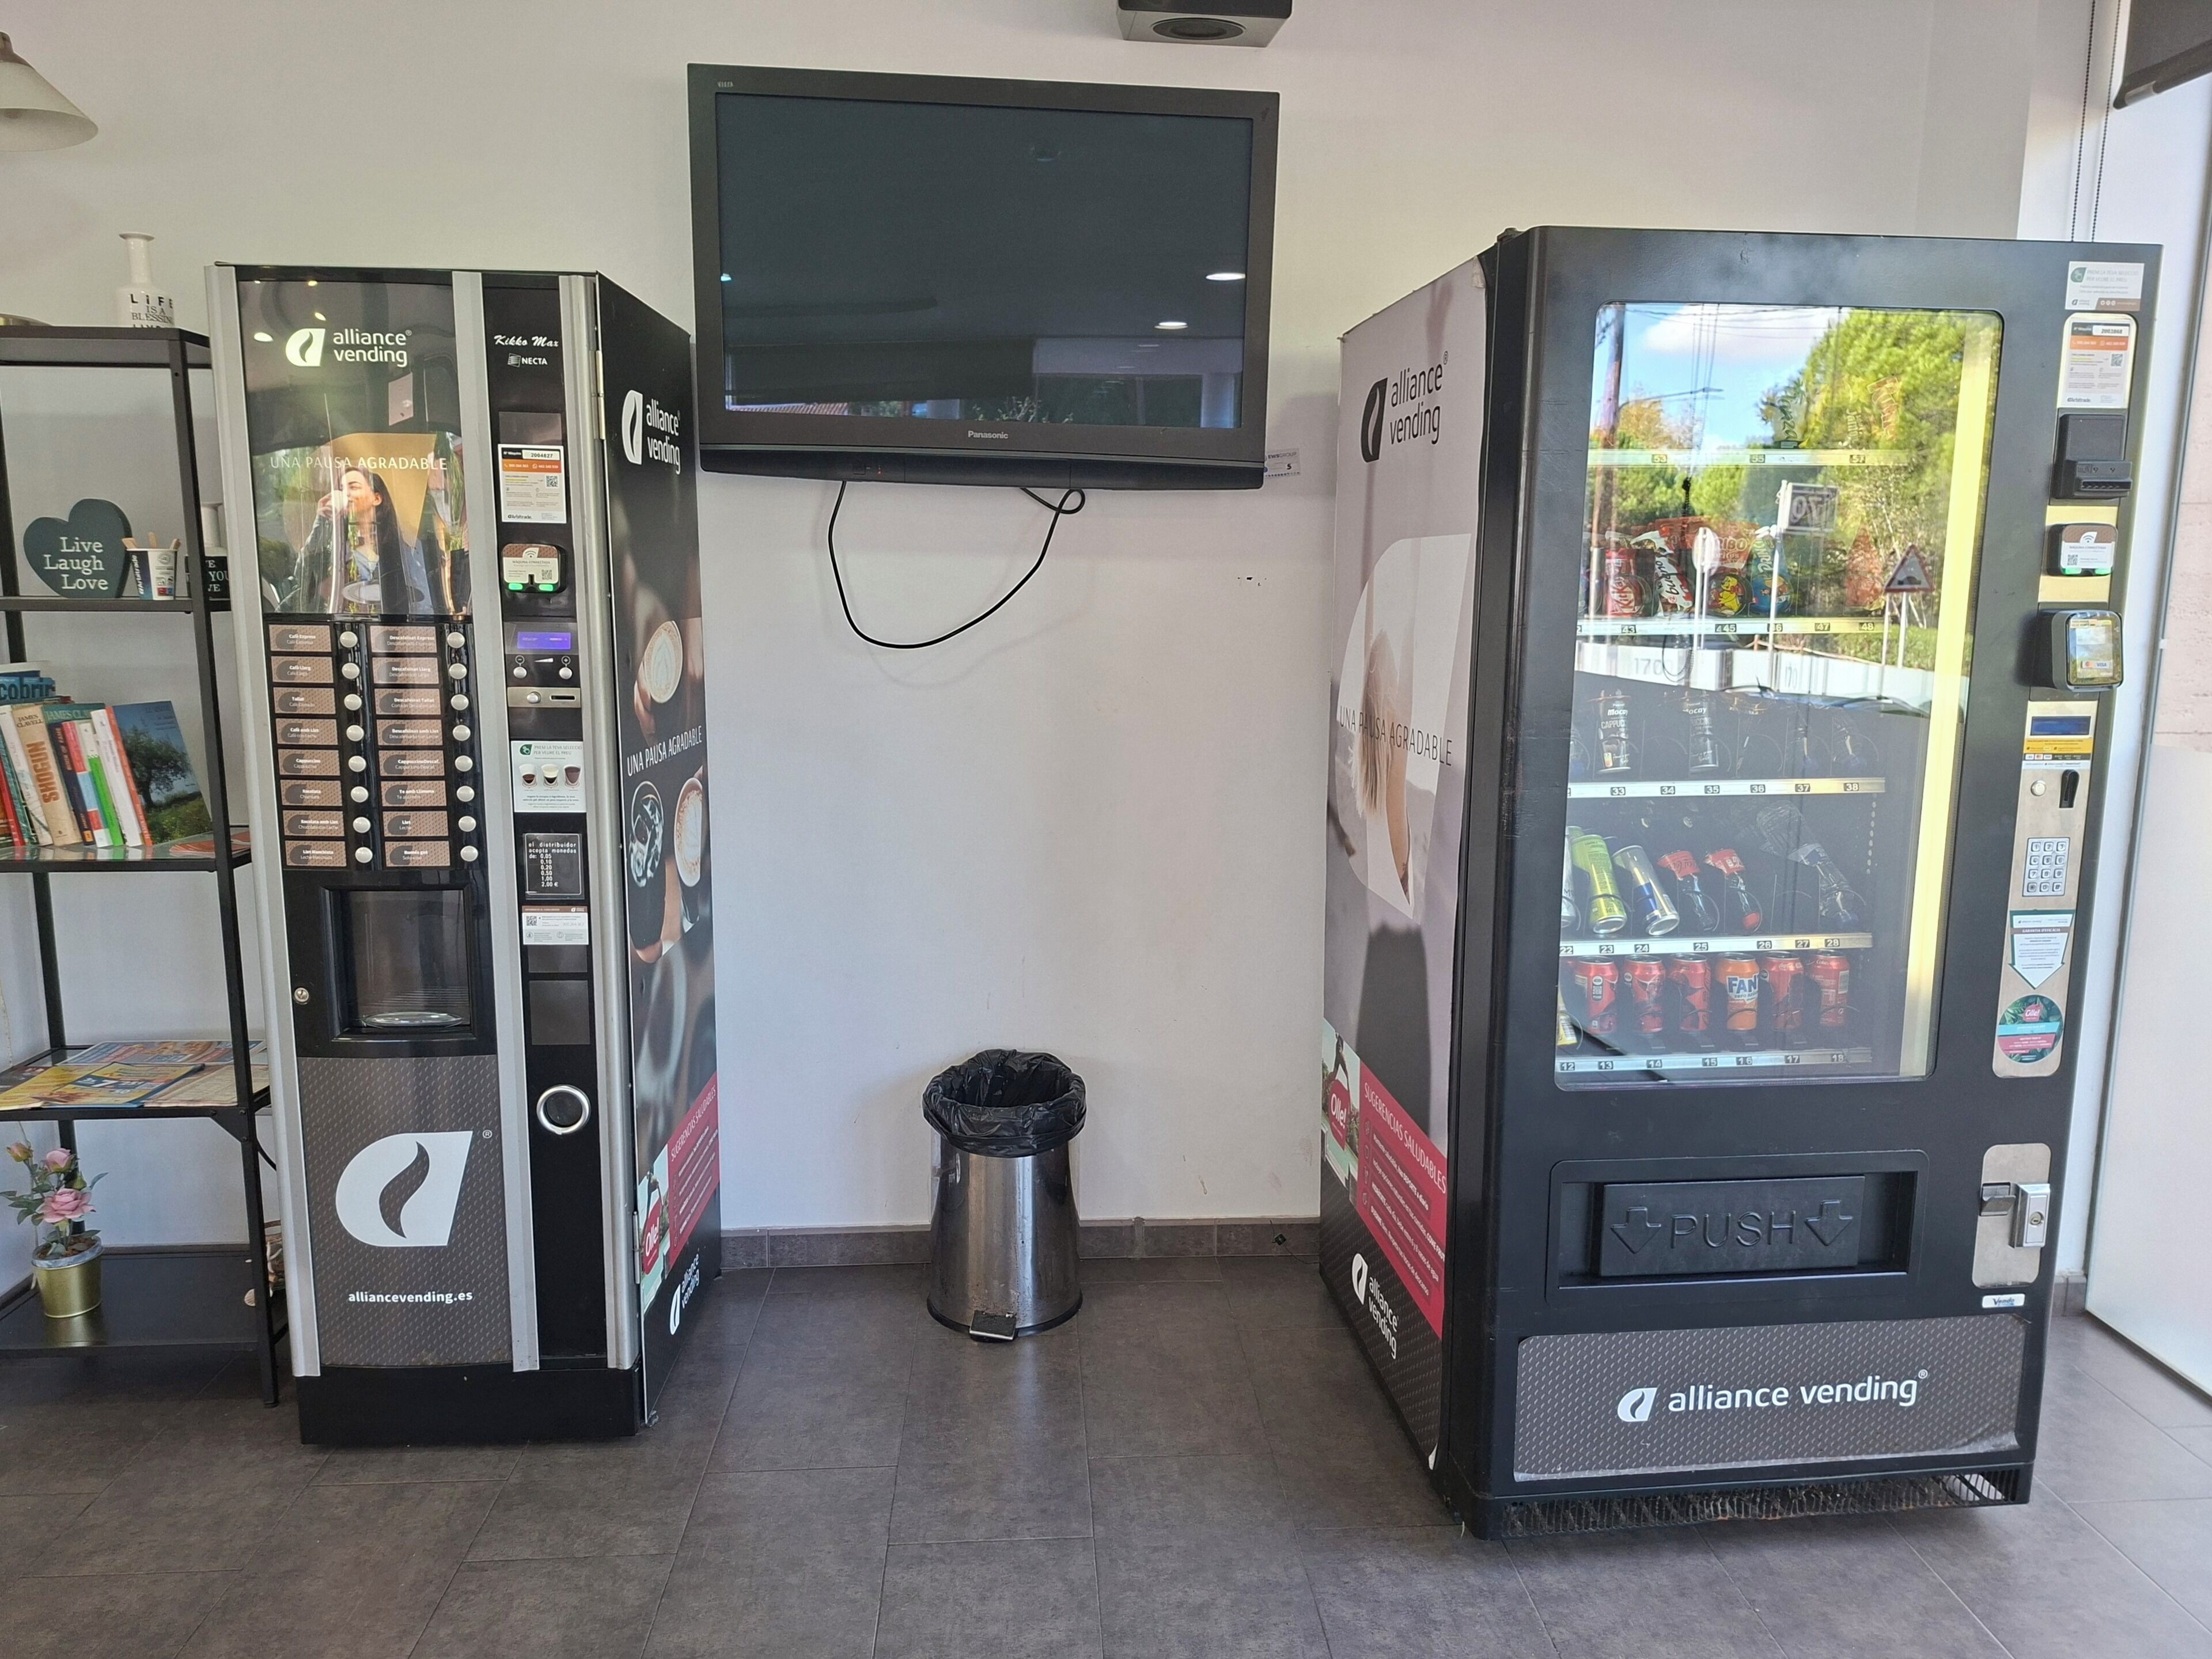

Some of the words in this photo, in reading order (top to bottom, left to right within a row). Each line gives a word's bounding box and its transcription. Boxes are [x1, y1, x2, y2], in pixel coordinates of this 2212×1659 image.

[131, 312, 175, 325] BLESSIN
[332, 328, 407, 346] alliance
[493, 335, 528, 347] Kikko
[531, 336, 559, 347] Max
[334, 347, 408, 367] vending
[521, 356, 548, 366] NECTA
[1391, 362, 1444, 408] alliance
[646, 398, 679, 437] alliance
[1390, 404, 1441, 446] vending
[968, 430, 1009, 439] Panasonic
[647, 436, 681, 475] vending
[270, 457, 301, 469] UNA
[306, 457, 351, 469] PAUSA
[358, 456, 448, 470] AGRADABLE
[60, 536, 103, 554] Live
[1718, 536, 1748, 551] RIBO
[44, 554, 105, 576] Laugh
[62, 574, 108, 591] Love
[1622, 625, 1636, 633] 43
[1816, 622, 1830, 631] 47
[1861, 622, 1874, 631] 48
[17, 719, 44, 729] CLAVELL
[18, 714, 39, 722] JAMES
[1340, 705, 1356, 731] UNA
[1358, 713, 1387, 743] PAUSA
[1390, 720, 1453, 768] AGRADABLE
[627, 752, 645, 777] UNA
[645, 741, 668, 768] PAUSA
[668, 725, 703, 757] AGRADABLE
[26, 741, 60, 804] SHOGUN
[1752, 785, 1766, 793] 36
[1797, 784, 1810, 792] 37
[1845, 783, 1859, 791] 38
[1758, 941, 1771, 949] 26
[1796, 940, 1809, 948] 27
[1826, 938, 1839, 947] 28
[1648, 1060, 1662, 1068] 14
[1704, 1059, 1717, 1067] 15
[1738, 1056, 1752, 1065] 16
[1786, 1055, 1799, 1063] 17
[1832, 1054, 1844, 1062] 18
[1561, 1063, 1574, 1071] 12
[1600, 1062, 1613, 1070] 13
[1330, 1092, 1347, 1129] Olle!
[1364, 1081, 1404, 1141] SUGERENCIAS
[1403, 1132, 1446, 1194] SALUDABLES
[1671, 1210, 1797, 1249] PUSH
[645, 1217, 660, 1257] Olle!
[681, 1253, 699, 1292] alliance
[682, 1268, 699, 1309] vending
[348, 1291, 474, 1304] alliancevending.es
[1368, 1276, 1398, 1332] alliance
[1368, 1296, 1397, 1359] vending
[1668, 1384, 1789, 1413] alliance
[1801, 1374, 1918, 1407] vending
